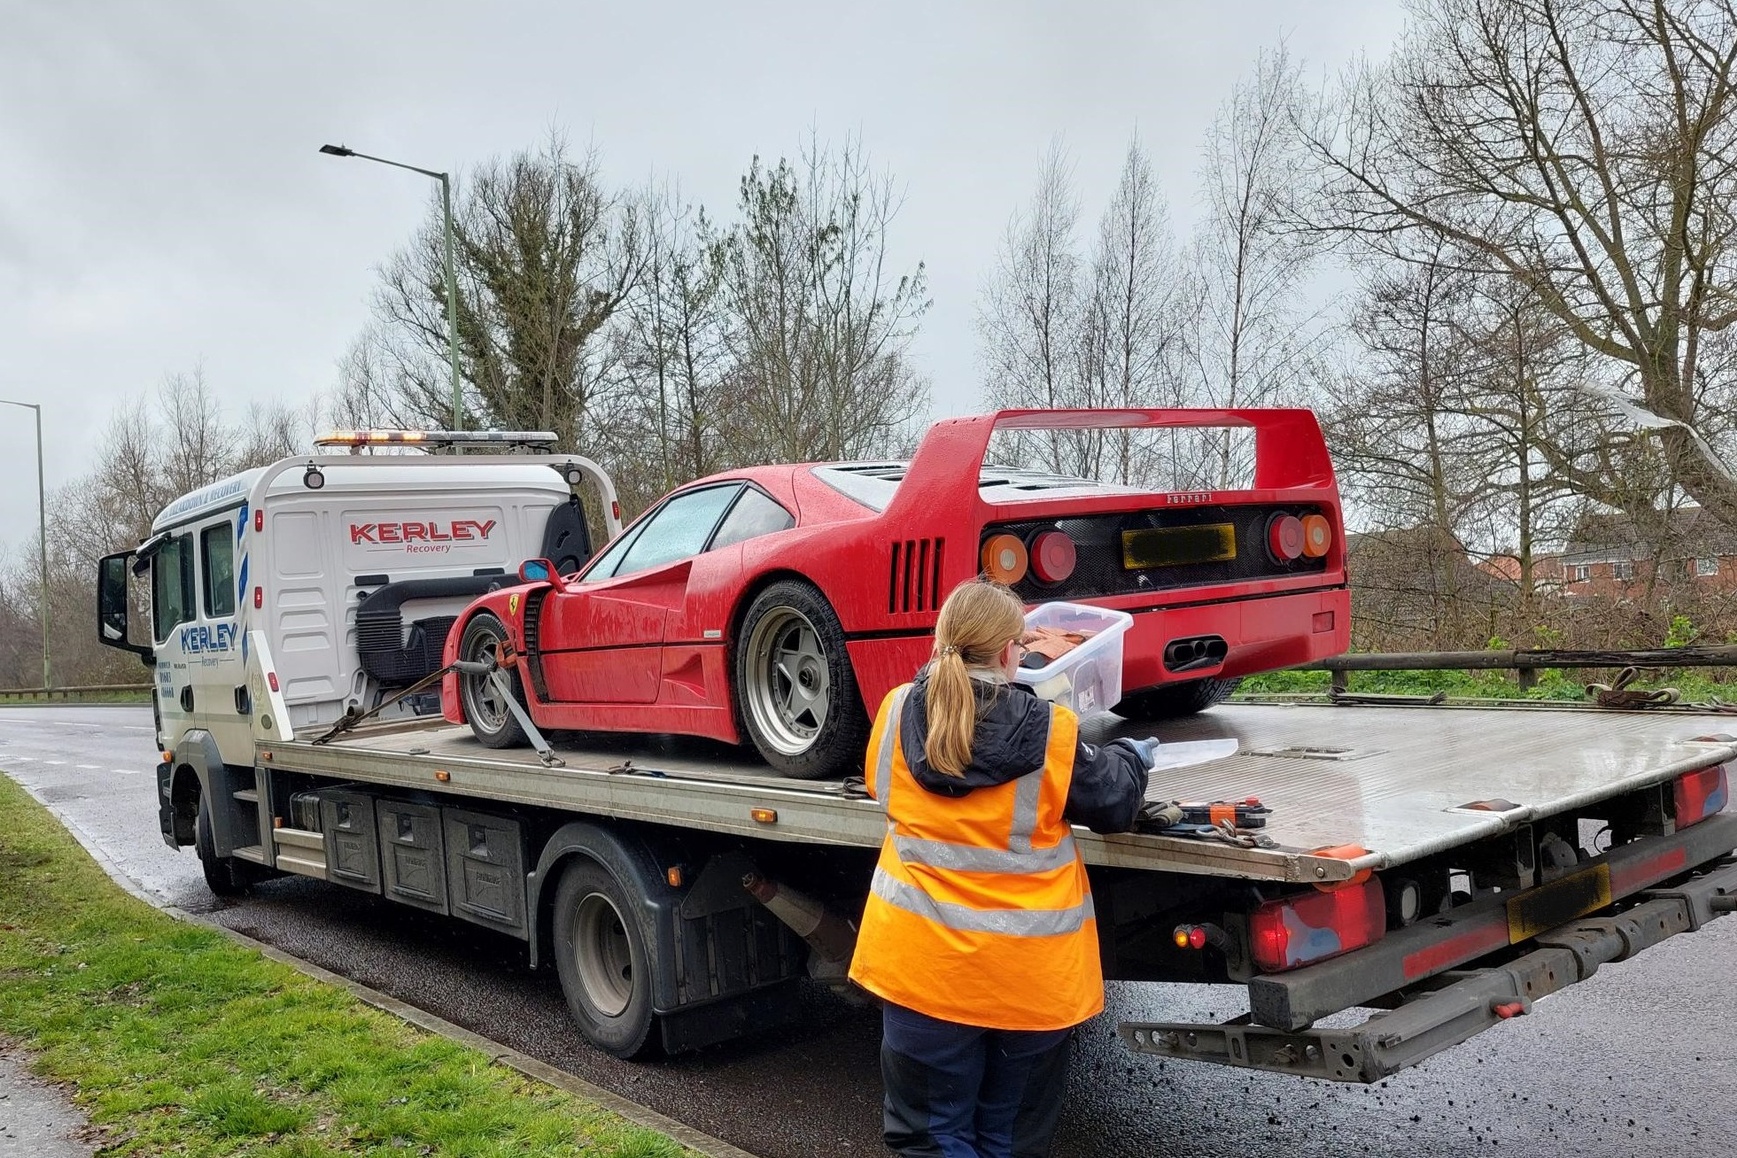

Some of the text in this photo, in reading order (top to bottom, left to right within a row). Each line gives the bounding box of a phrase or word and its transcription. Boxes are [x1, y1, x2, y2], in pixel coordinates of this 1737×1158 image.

[1167, 493, 1212, 504] Ferrari
[350, 520, 497, 545] KERLEY
[406, 544, 451, 554] Recovery
[181, 623, 238, 654] KERLEY
[202, 656, 218, 669] Recovery
